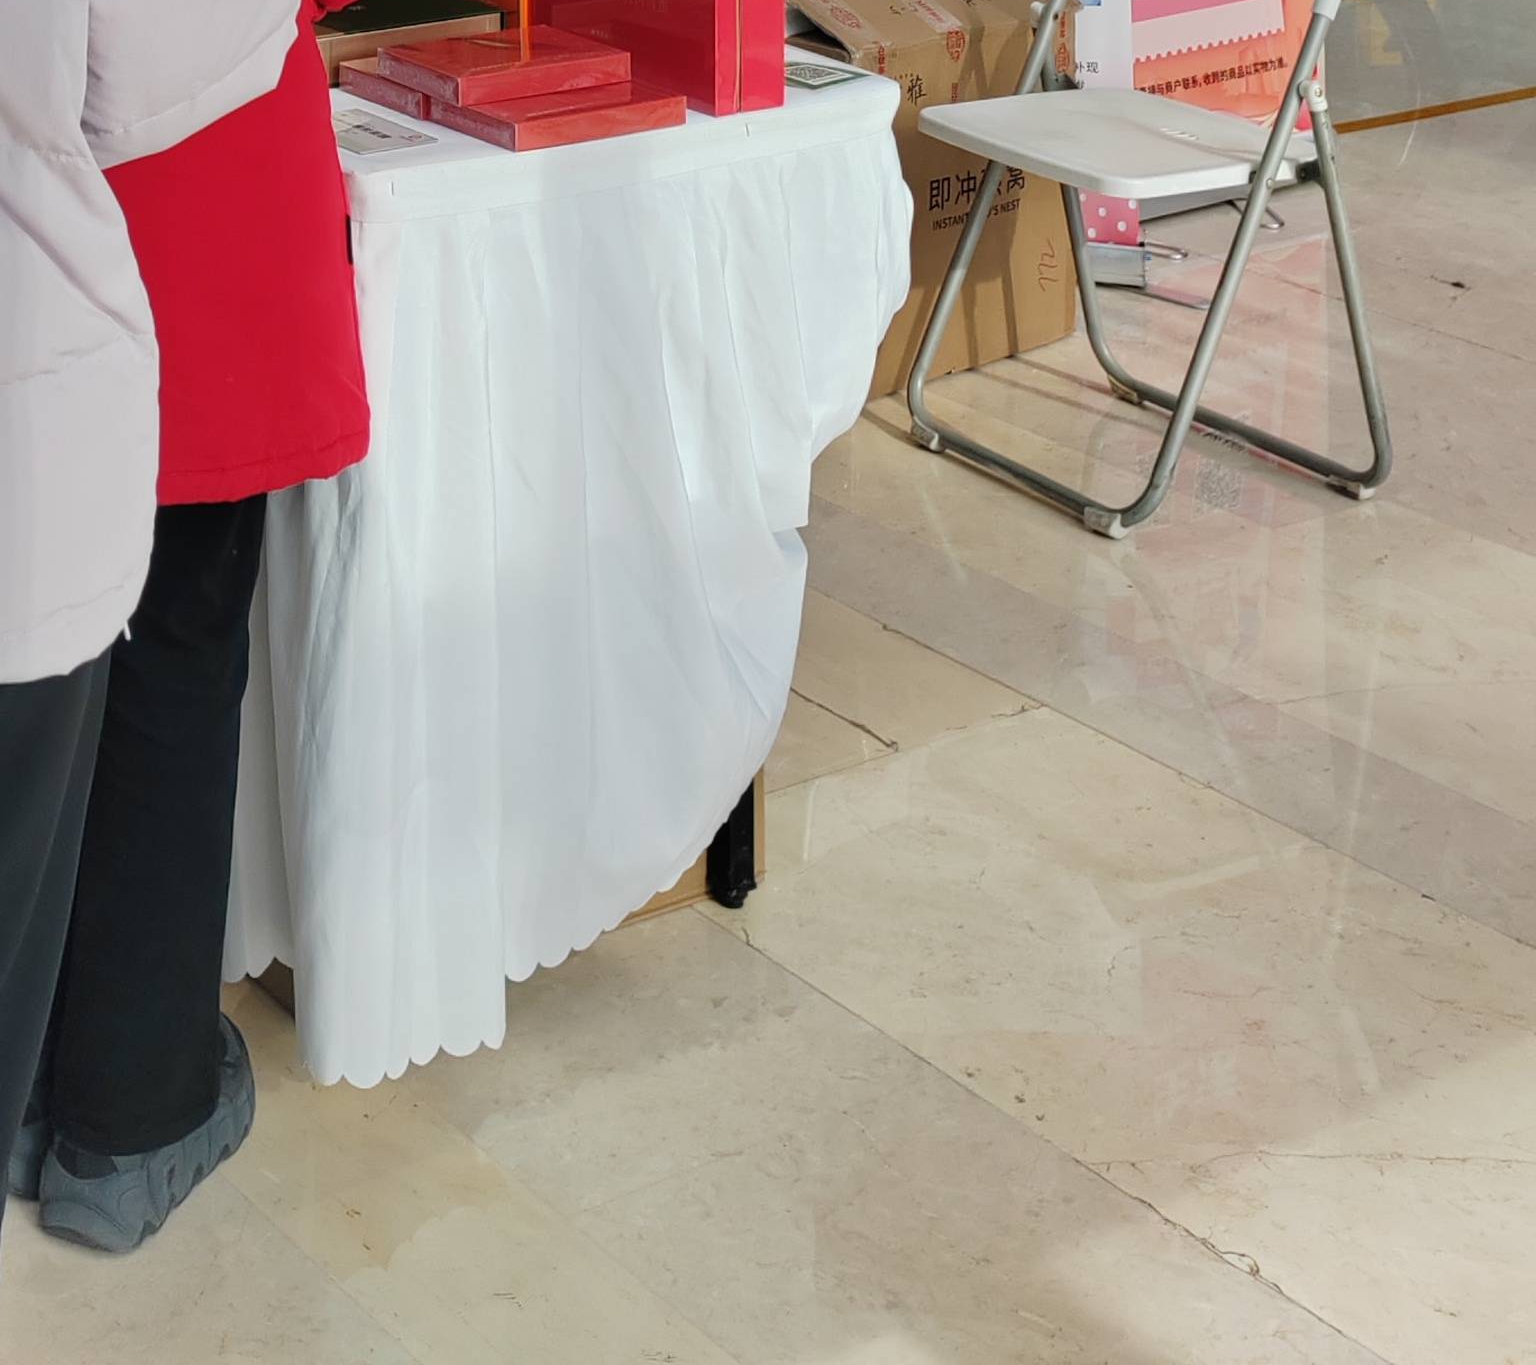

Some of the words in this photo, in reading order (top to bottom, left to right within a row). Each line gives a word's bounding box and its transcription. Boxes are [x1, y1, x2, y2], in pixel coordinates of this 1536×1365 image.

[906, 74, 927, 106] 雅
[929, 166, 1025, 211] 即冲窝
[1000, 198, 1021, 213] NEST
